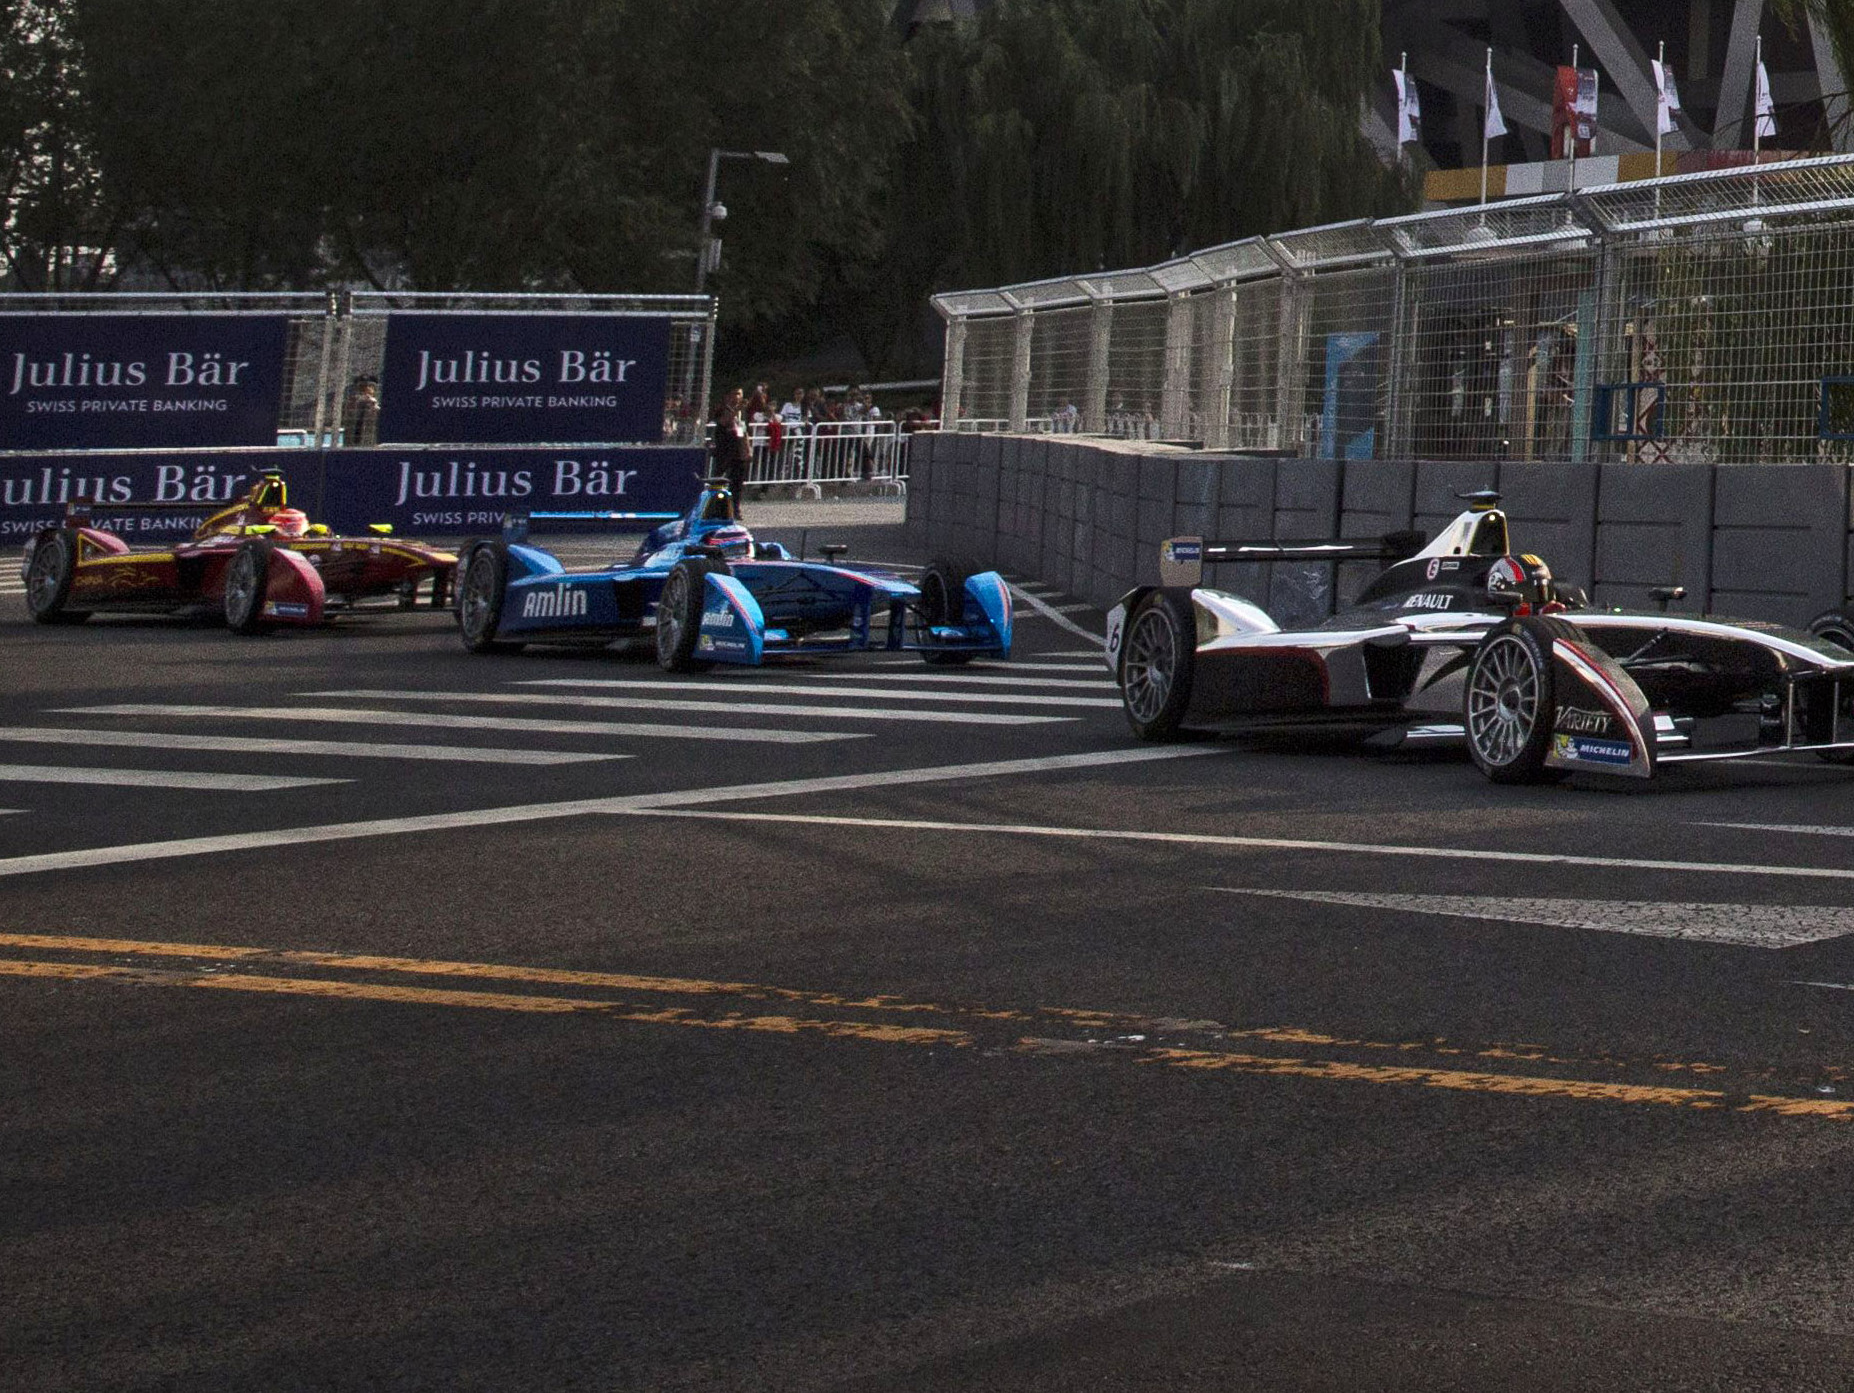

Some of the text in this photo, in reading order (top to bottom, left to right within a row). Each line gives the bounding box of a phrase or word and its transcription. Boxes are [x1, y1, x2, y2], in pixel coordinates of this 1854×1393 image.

[9, 352, 250, 395] Julius Bär
[415, 350, 637, 391] Julius Bär
[27, 399, 228, 413] SWISS PRIVATE BANKING
[432, 395, 618, 408] SWISS PRIVATE BANKING
[1, 464, 247, 506] ulius Bär
[394, 460, 638, 506] Julius Bär
[412, 512, 462, 525] SWISS
[1110, 623, 1120, 653] 6
[1580, 744, 1630, 757] MICHELIN
